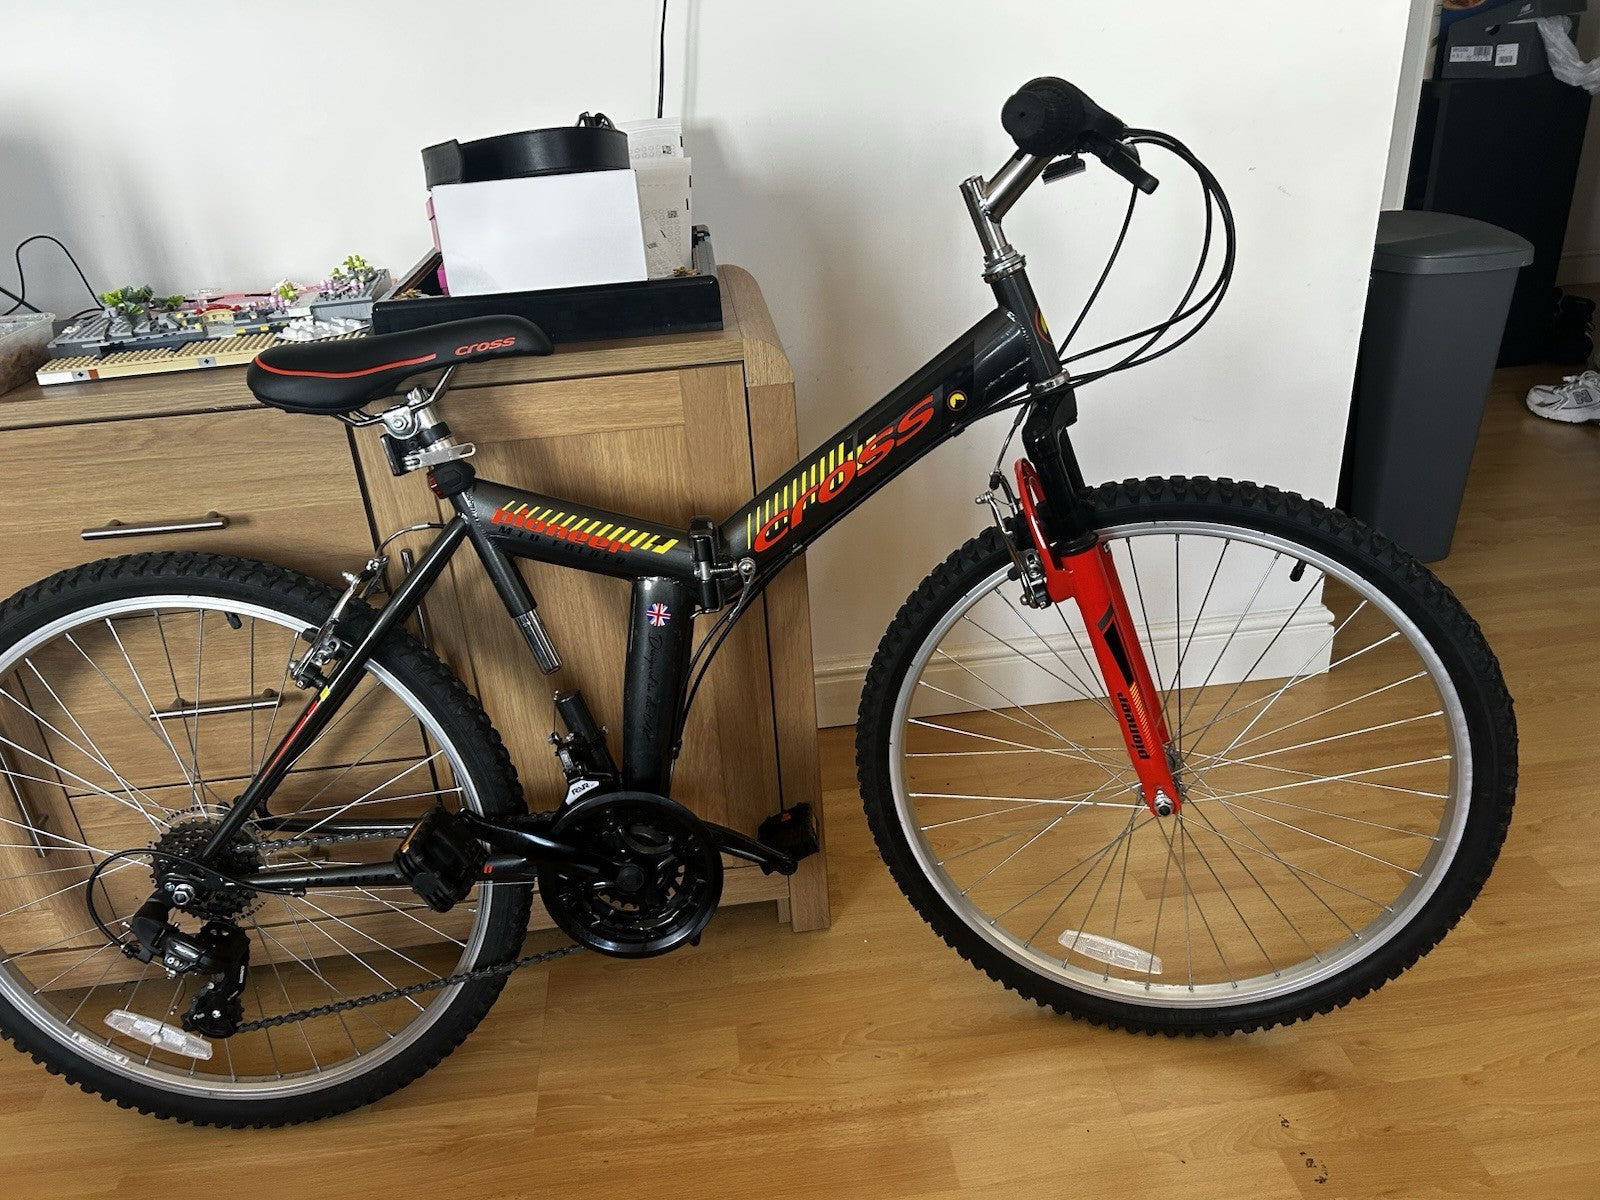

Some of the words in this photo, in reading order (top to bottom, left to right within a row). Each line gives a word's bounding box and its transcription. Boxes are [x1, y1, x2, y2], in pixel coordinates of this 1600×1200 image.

[455, 337, 516, 356] cross
[753, 394, 935, 553] cross
[490, 507, 632, 553] pioneer
[1116, 692, 1151, 760] pioneer
